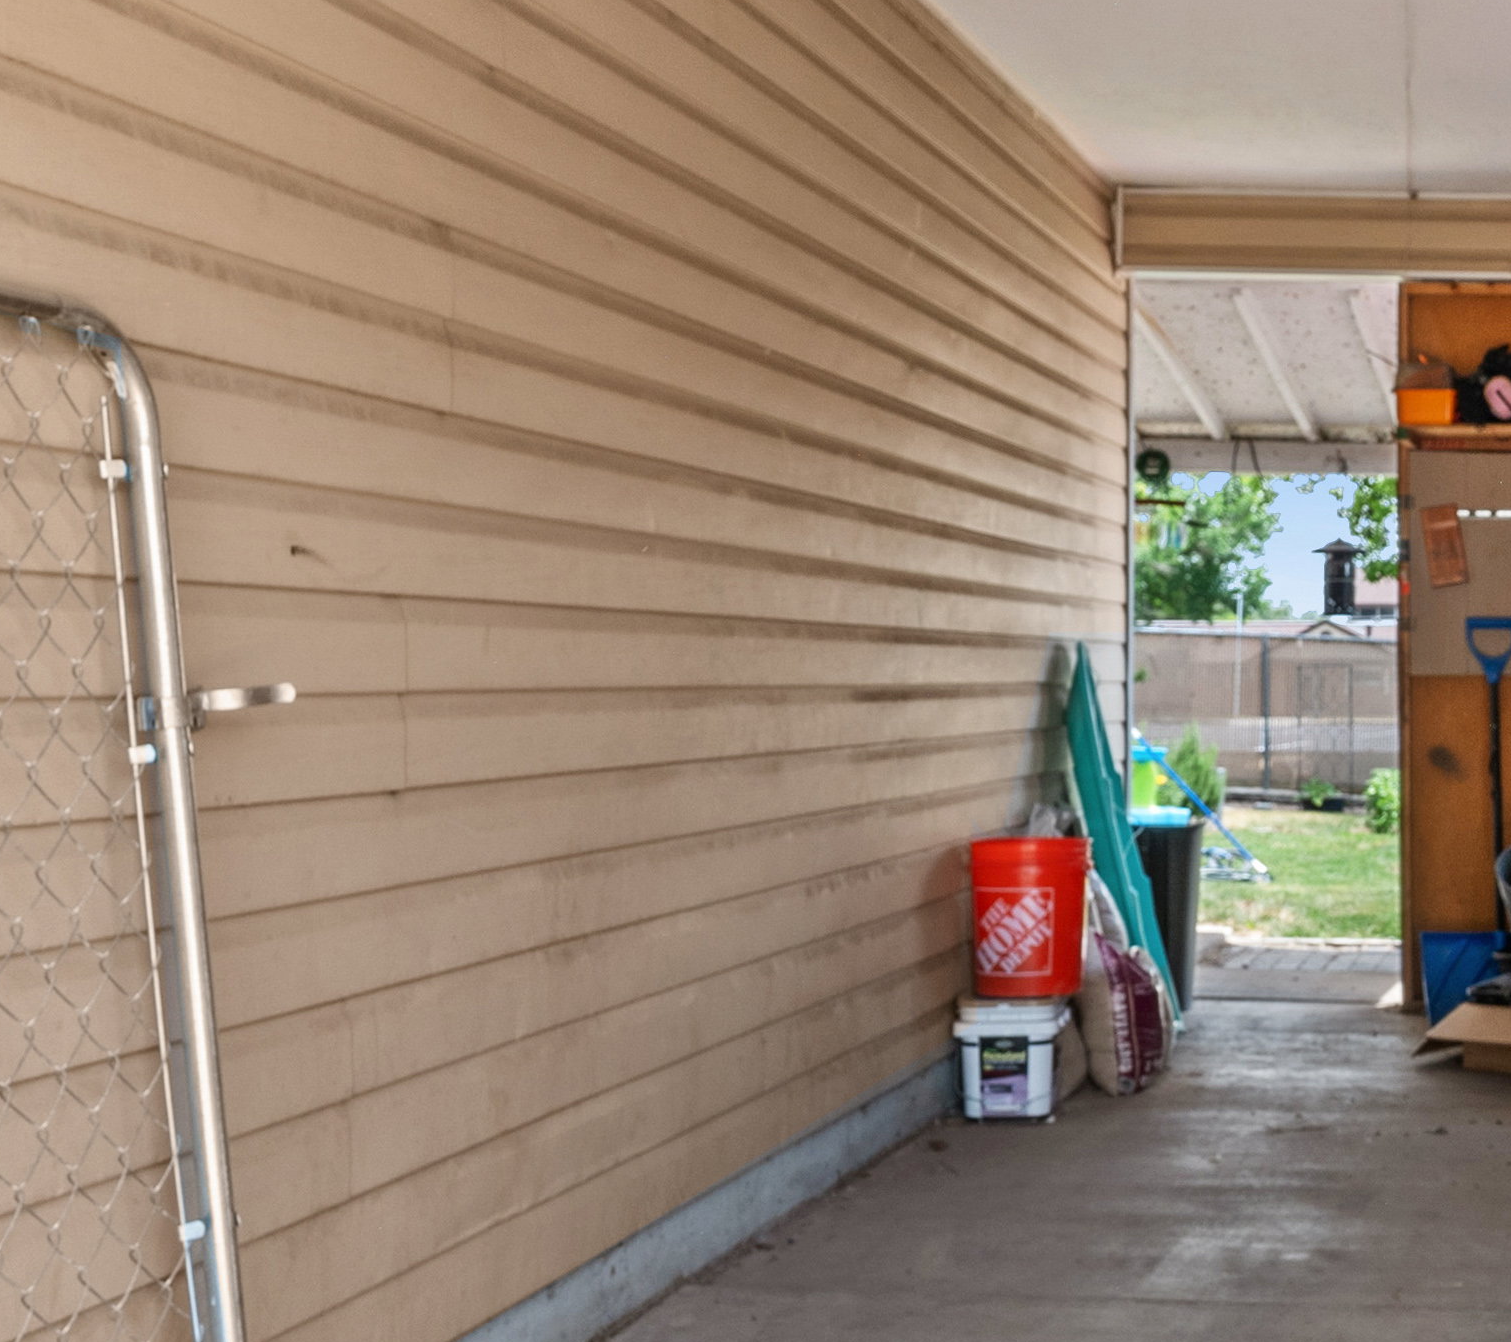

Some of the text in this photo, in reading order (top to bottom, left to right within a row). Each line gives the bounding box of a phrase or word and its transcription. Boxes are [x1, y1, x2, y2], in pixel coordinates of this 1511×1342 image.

[976, 888, 1052, 973] HOME
[980, 897, 1011, 932] THE
[999, 921, 1053, 974] DEPOT
